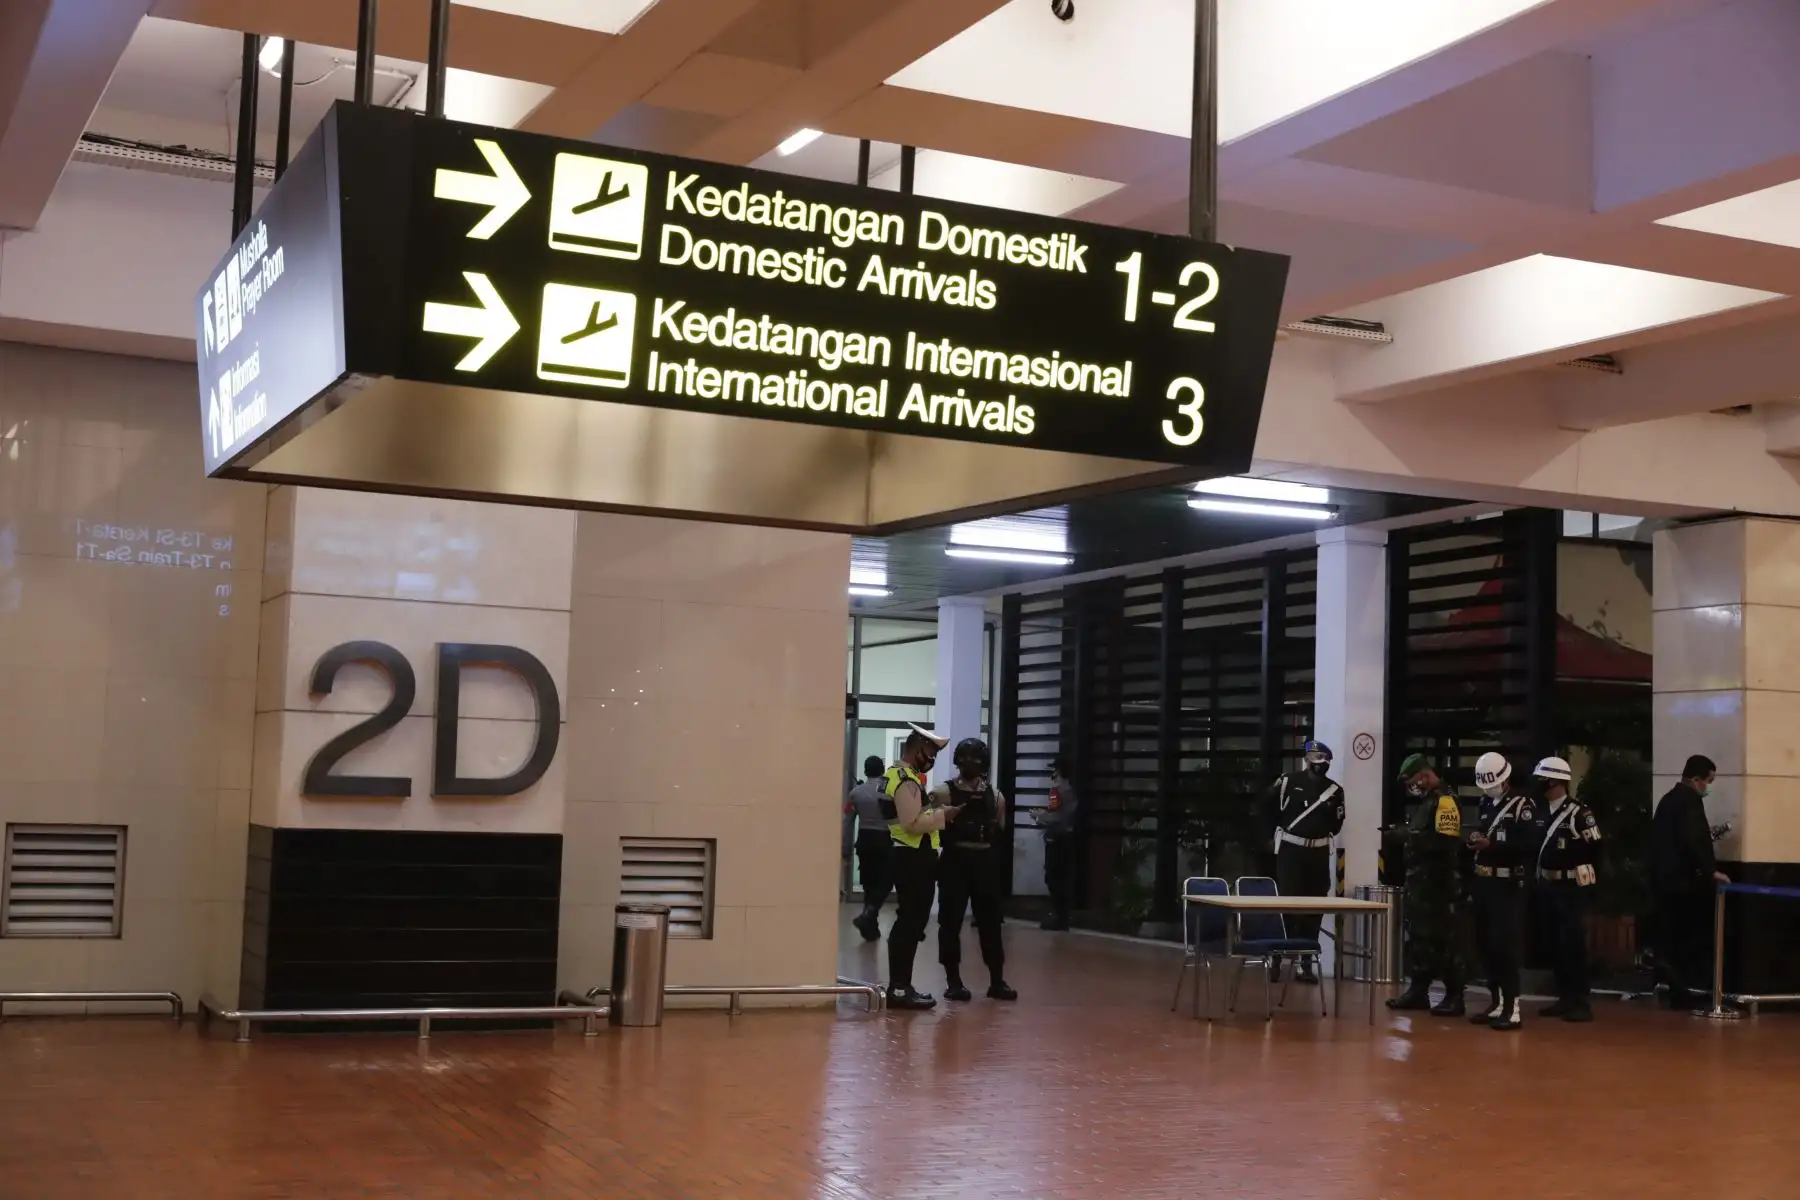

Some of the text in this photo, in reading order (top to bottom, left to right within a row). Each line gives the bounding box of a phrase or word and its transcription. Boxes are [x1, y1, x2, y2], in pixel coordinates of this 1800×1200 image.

[665, 170, 1088, 273] Kedatangan Domestik
[242, 246, 284, 317] Prayer Room
[659, 223, 997, 310] Domestic Arrivals
[1115, 251, 1220, 333] 1-2
[651, 297, 1132, 397] Kedatangan Internasional
[646, 351, 1036, 435] International Arrivals
[1162, 376, 1205, 446] 3
[301, 640, 560, 798] 2D
[1440, 814, 1458, 822] PAM
